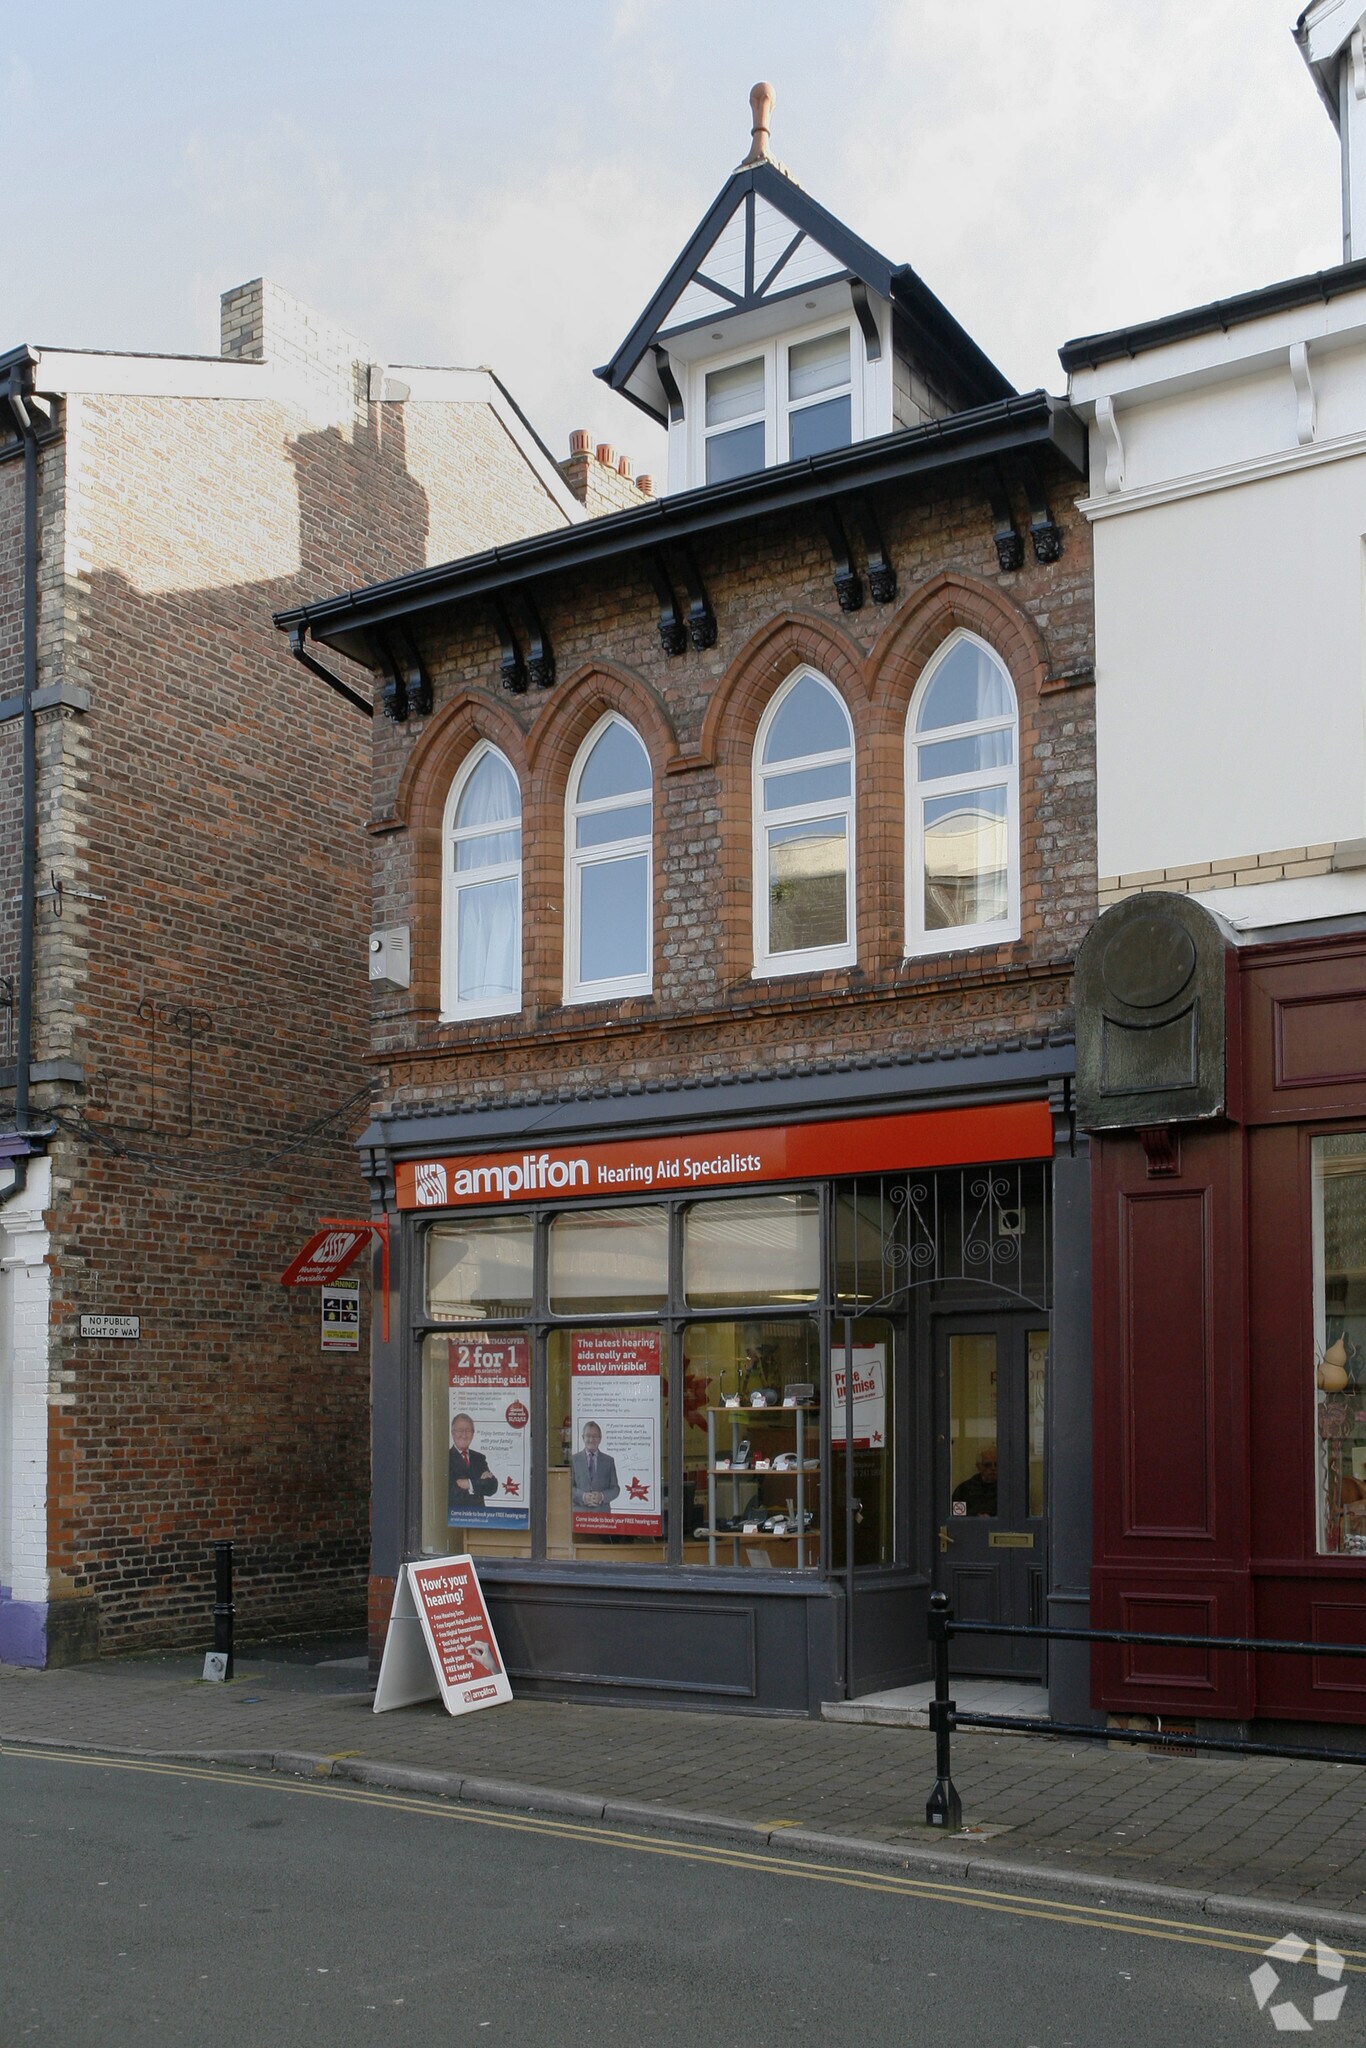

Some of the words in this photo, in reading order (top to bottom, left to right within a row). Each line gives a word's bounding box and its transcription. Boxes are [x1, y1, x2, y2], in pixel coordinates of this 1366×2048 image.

[598, 1164, 652, 1184] Hearing
[657, 1159, 680, 1178] Aid
[684, 1154, 761, 1180] Specialists
[454, 1154, 589, 1199] amplifon
[299, 1266, 324, 1274] Hearing
[294, 1275, 328, 1283] Specialists
[104, 1317, 130, 1325] PUBLIC
[122, 1328, 138, 1336] WAY
[577, 1340, 593, 1348] The
[595, 1339, 620, 1347] latest
[622, 1338, 654, 1349] hearing
[458, 1346, 470, 1367] 2
[474, 1346, 503, 1367] for
[508, 1346, 518, 1367] 1
[577, 1351, 594, 1359] aids
[596, 1350, 620, 1361] really
[577, 1362, 606, 1373] totally
[608, 1362, 646, 1371] invisible!
[452, 1375, 477, 1386] digital
[478, 1375, 508, 1386] hearing
[509, 1375, 526, 1384] aids
[835, 1372, 859, 1386] Pre
[837, 1380, 875, 1398] prmise
[421, 1576, 447, 1592] How's
[448, 1574, 467, 1590] your
[425, 1588, 464, 1607] hearing?
[443, 1656, 455, 1664] Book
[455, 1655, 465, 1663] your
[446, 1665, 457, 1673] FREE
[456, 1662, 474, 1671] hearing
[449, 1674, 458, 1682] test
[472, 1687, 495, 1698] amplifon
